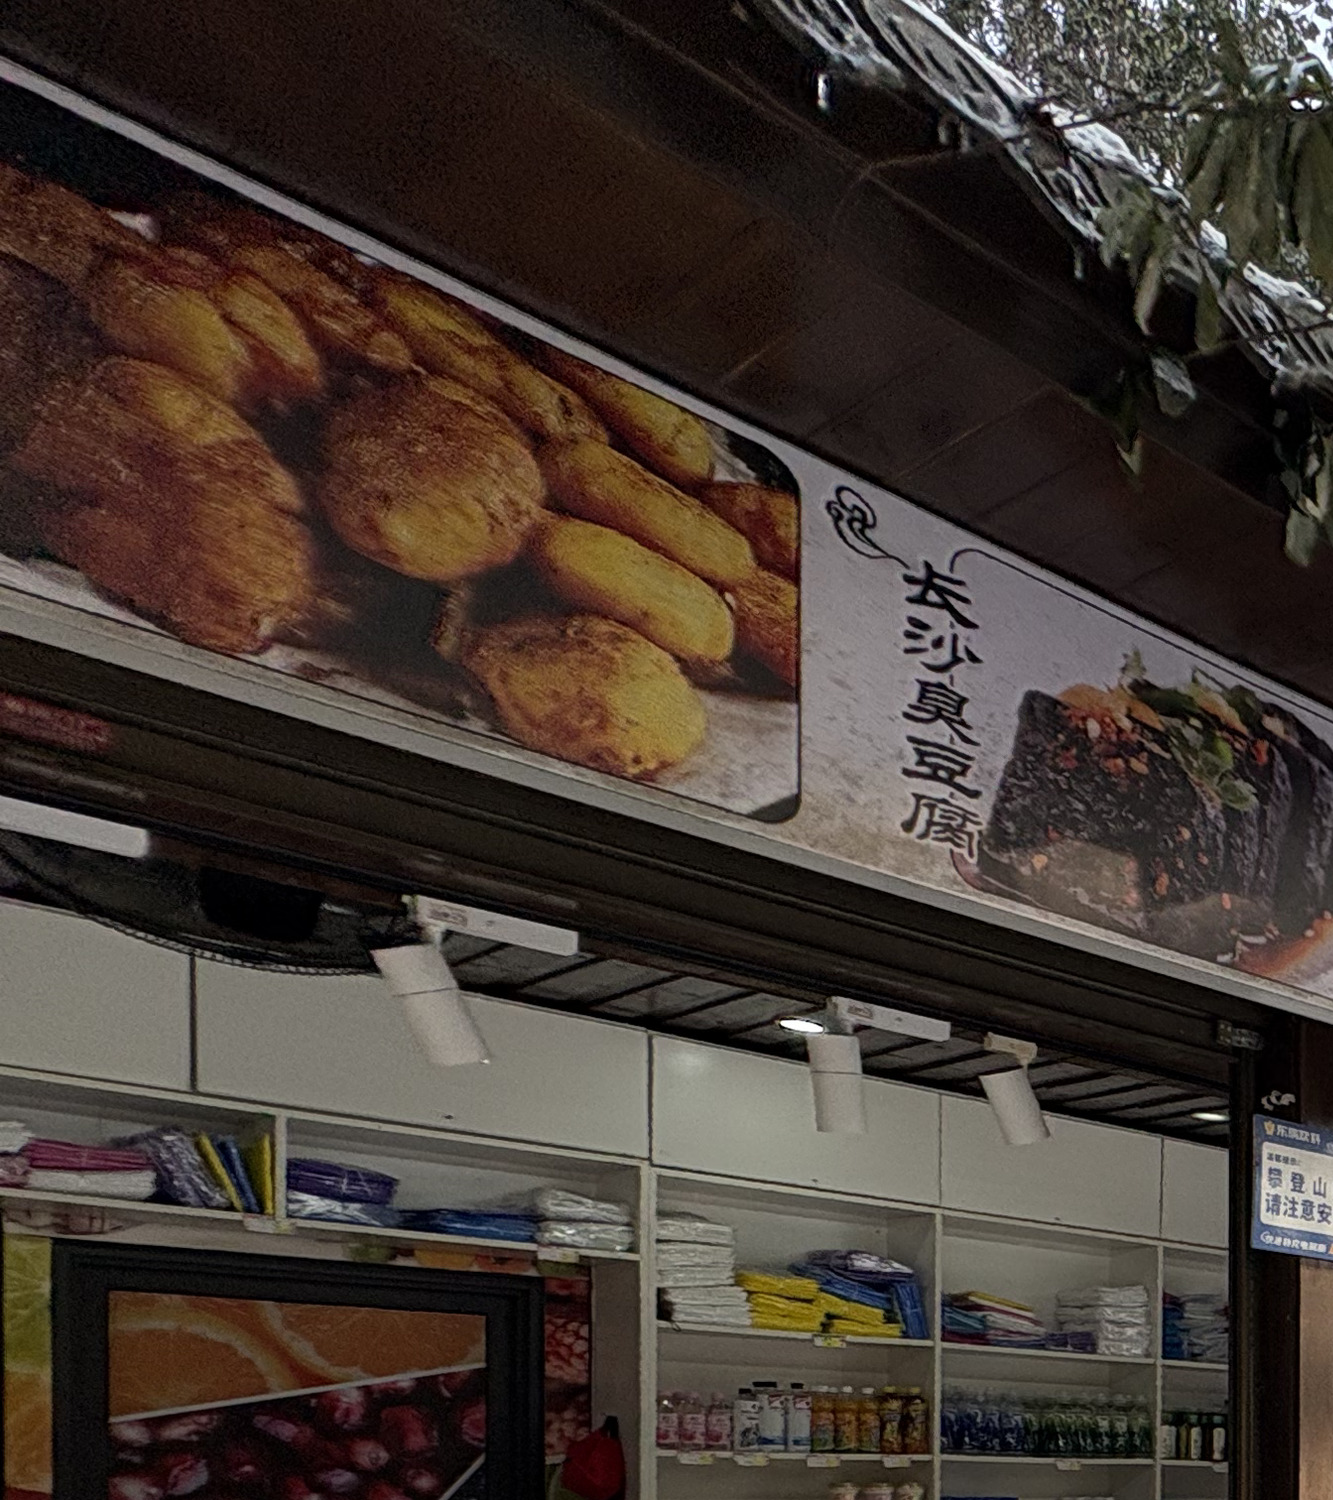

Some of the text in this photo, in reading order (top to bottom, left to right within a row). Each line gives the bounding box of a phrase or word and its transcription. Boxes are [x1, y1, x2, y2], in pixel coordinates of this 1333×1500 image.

[901, 560, 983, 860] 长沙臭豆腐
